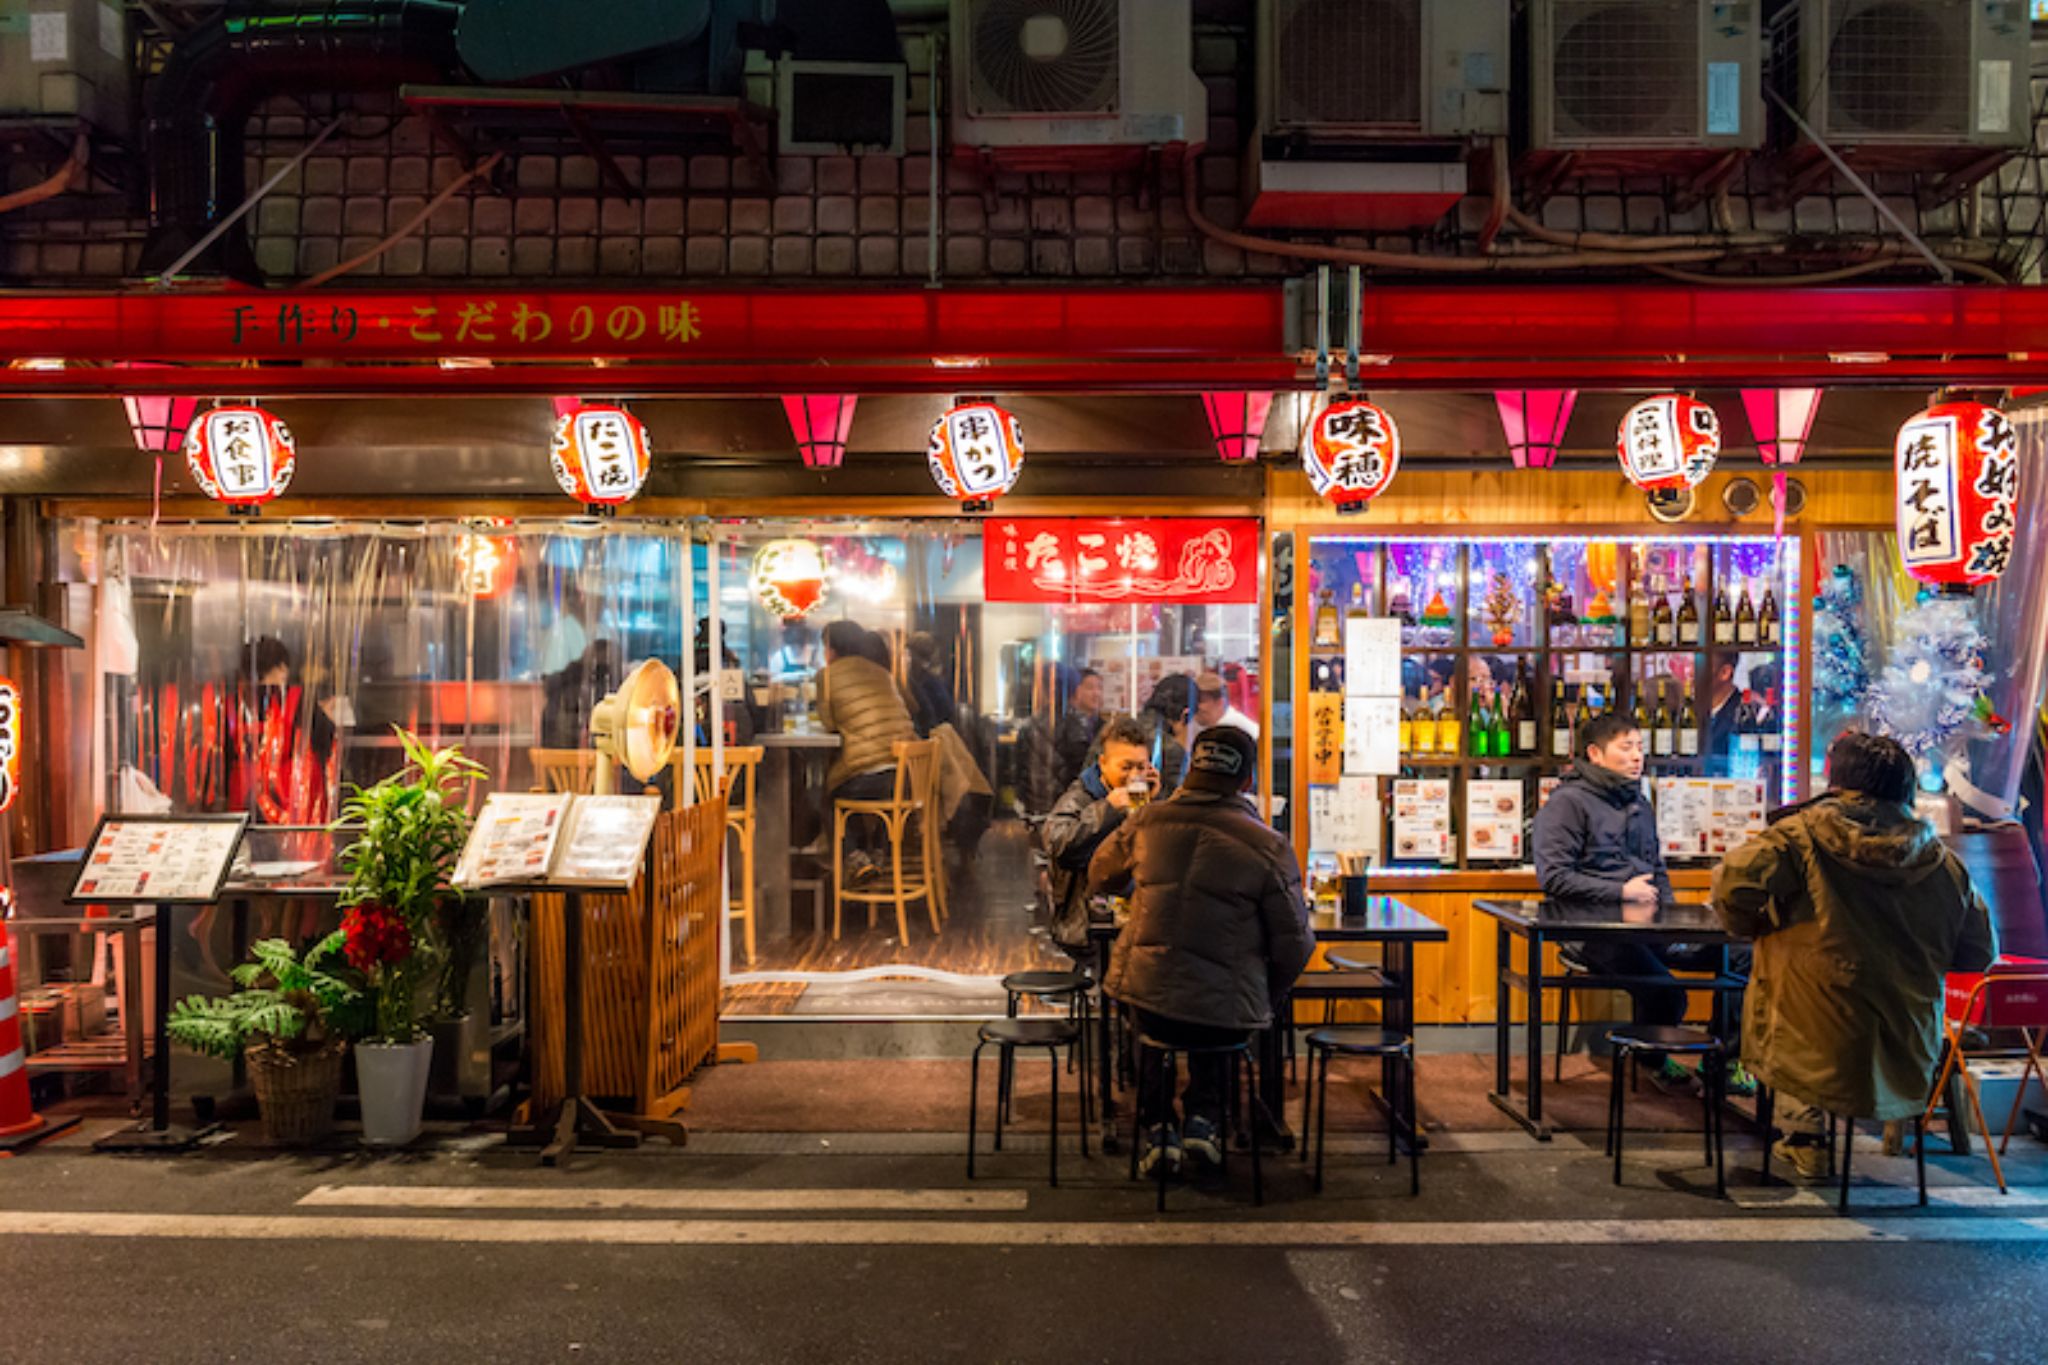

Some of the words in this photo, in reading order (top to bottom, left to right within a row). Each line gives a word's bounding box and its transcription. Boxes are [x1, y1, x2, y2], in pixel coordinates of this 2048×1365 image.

[223, 420, 257, 486] お食事
[589, 420, 629, 486] たこ焼
[958, 415, 997, 481] 串かつ
[1327, 407, 1383, 487] 味穂
[1903, 433, 1946, 552] 焼そば
[1024, 531, 1160, 580] たこ焼
